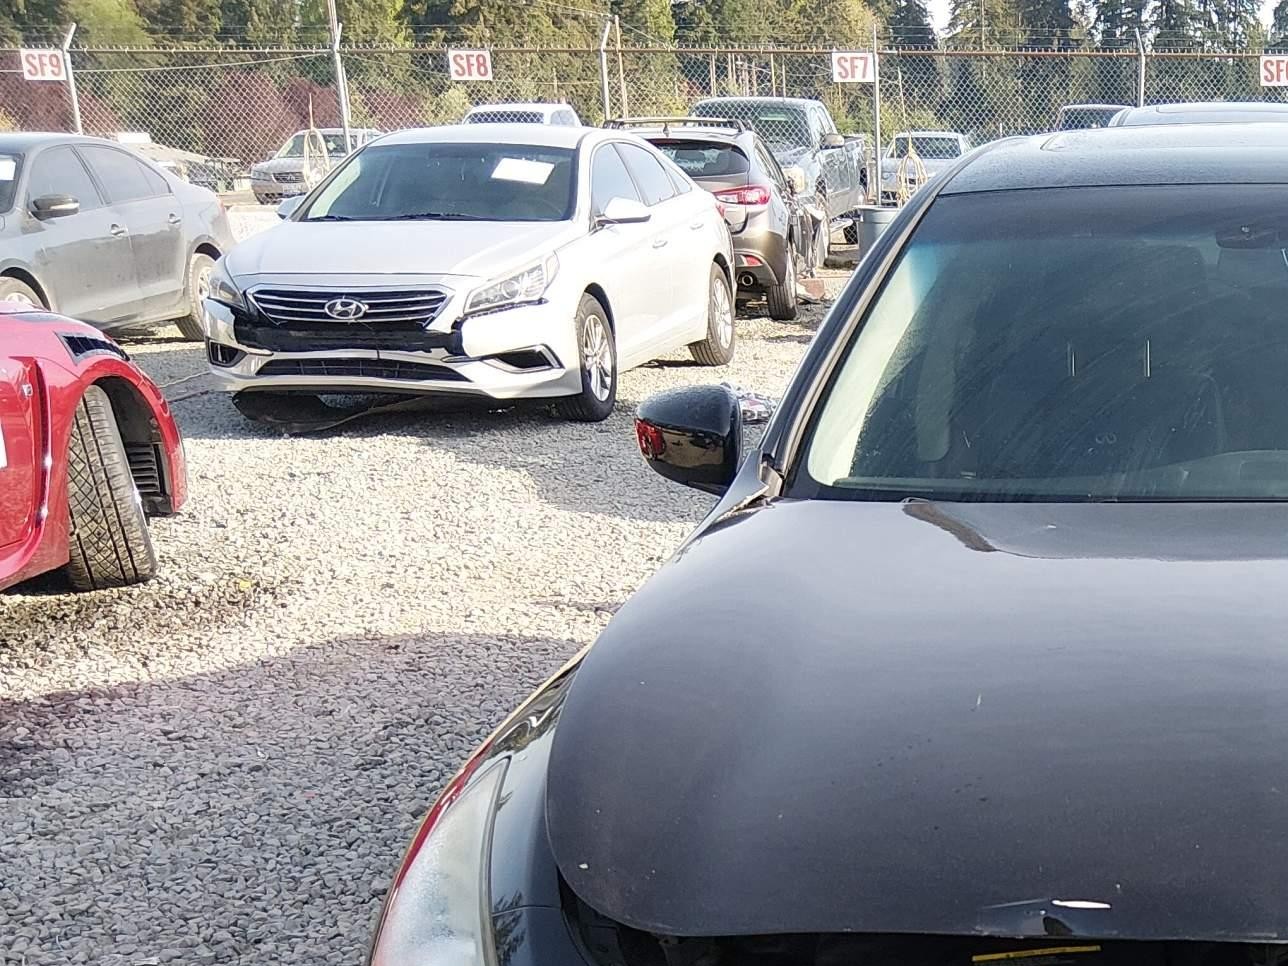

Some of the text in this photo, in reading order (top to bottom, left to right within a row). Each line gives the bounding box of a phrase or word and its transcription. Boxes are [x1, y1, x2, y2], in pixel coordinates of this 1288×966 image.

[24, 53, 62, 77] SF9
[452, 53, 489, 77] SF8
[837, 56, 868, 79] SF7
